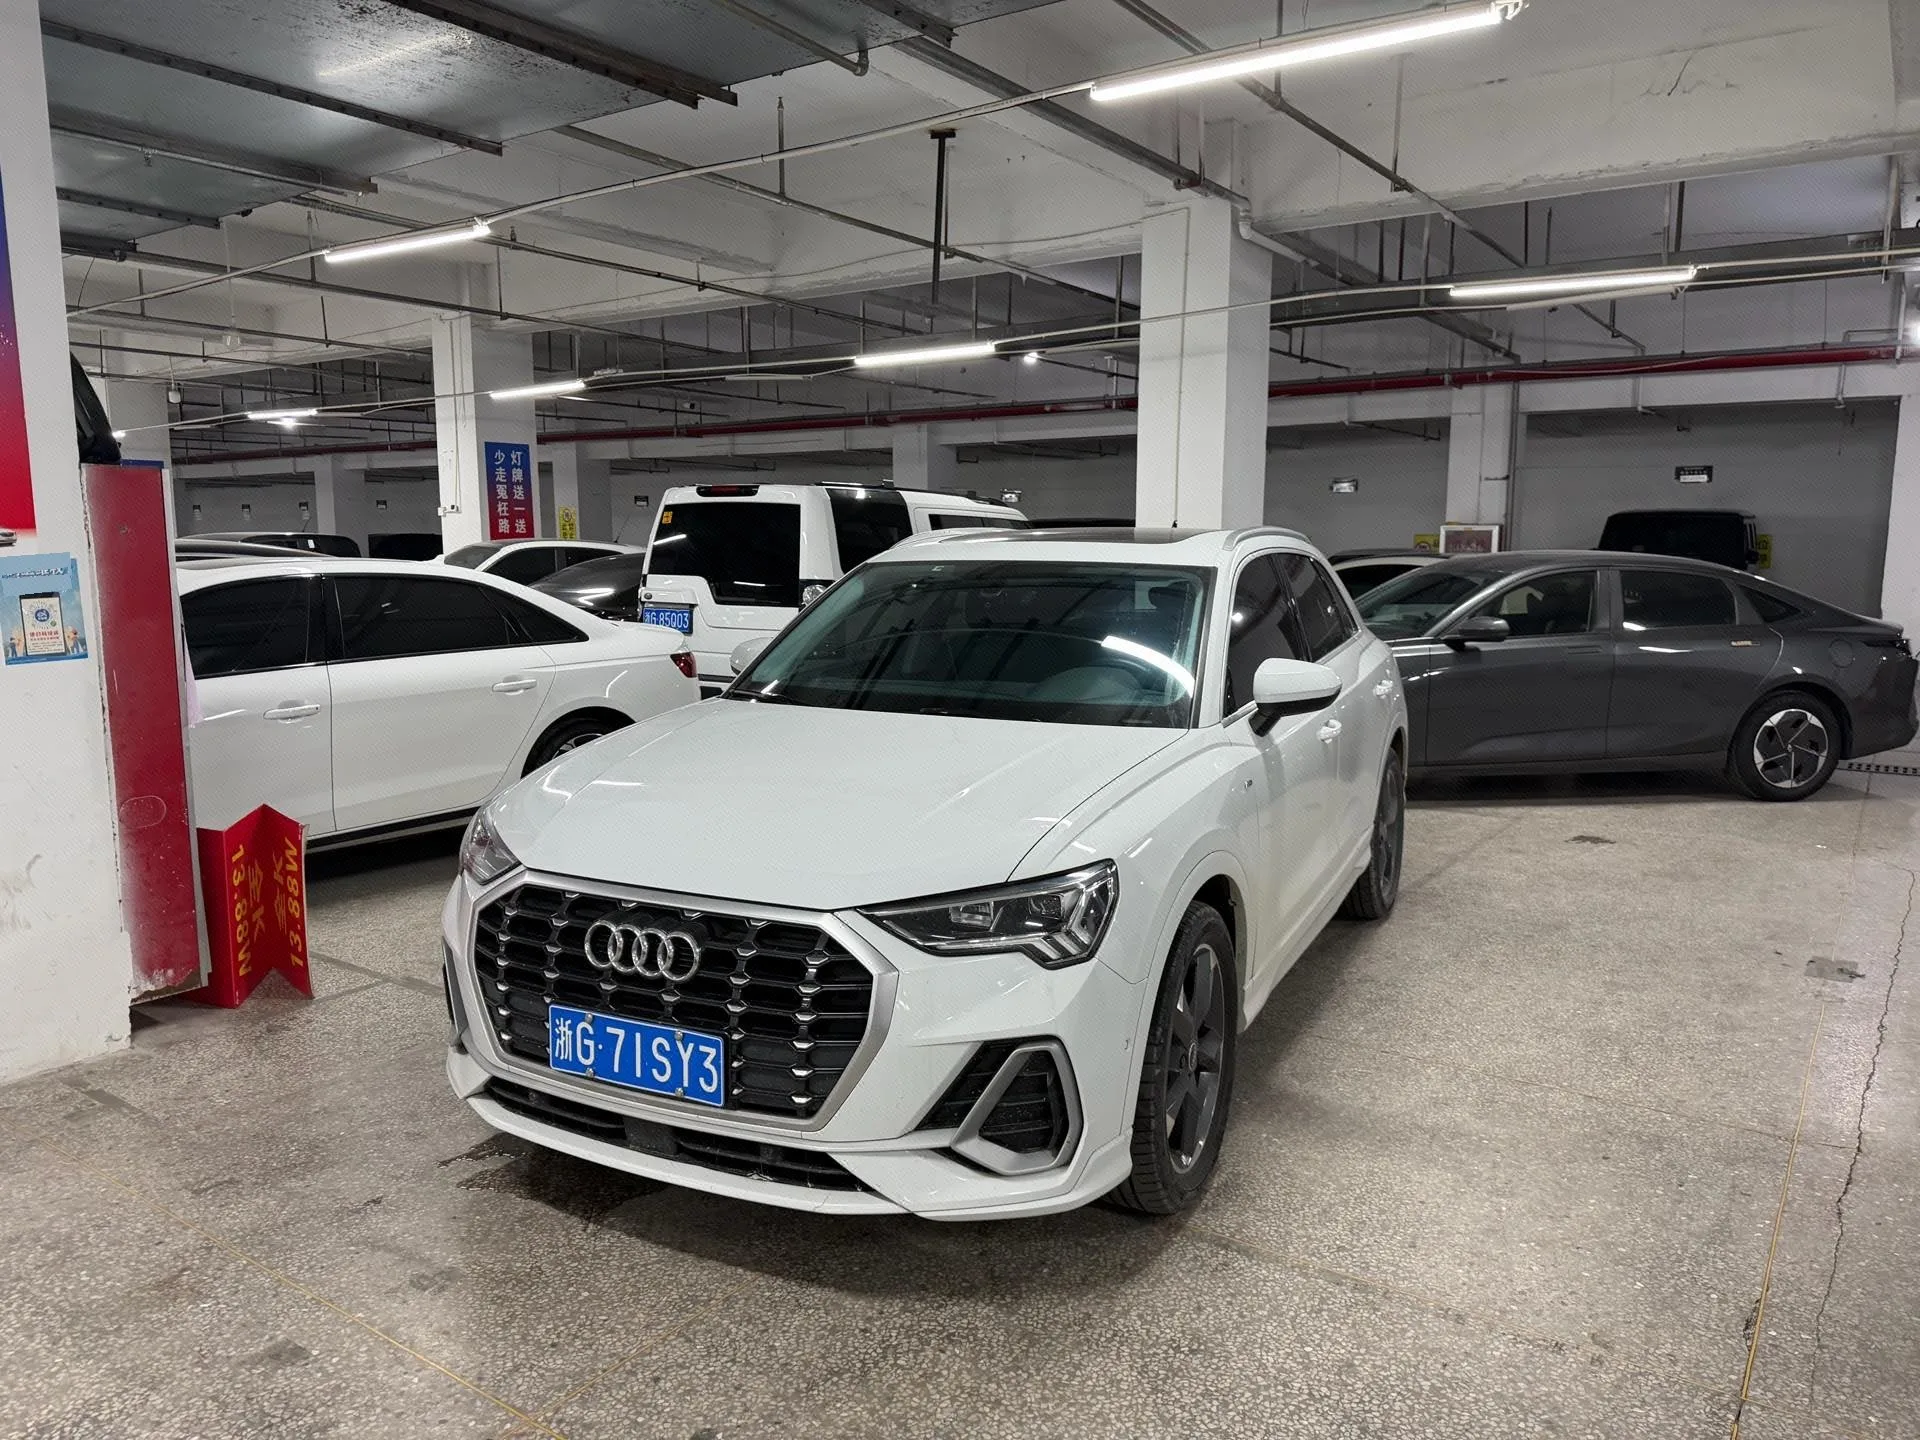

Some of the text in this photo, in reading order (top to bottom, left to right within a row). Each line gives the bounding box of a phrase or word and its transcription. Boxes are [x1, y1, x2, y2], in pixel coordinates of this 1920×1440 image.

[494, 449, 510, 534] 少走冤枉路
[510, 450, 527, 534] 灯牌送一送
[231, 844, 252, 977] 13.88W
[284, 836, 304, 967] 13.88W
